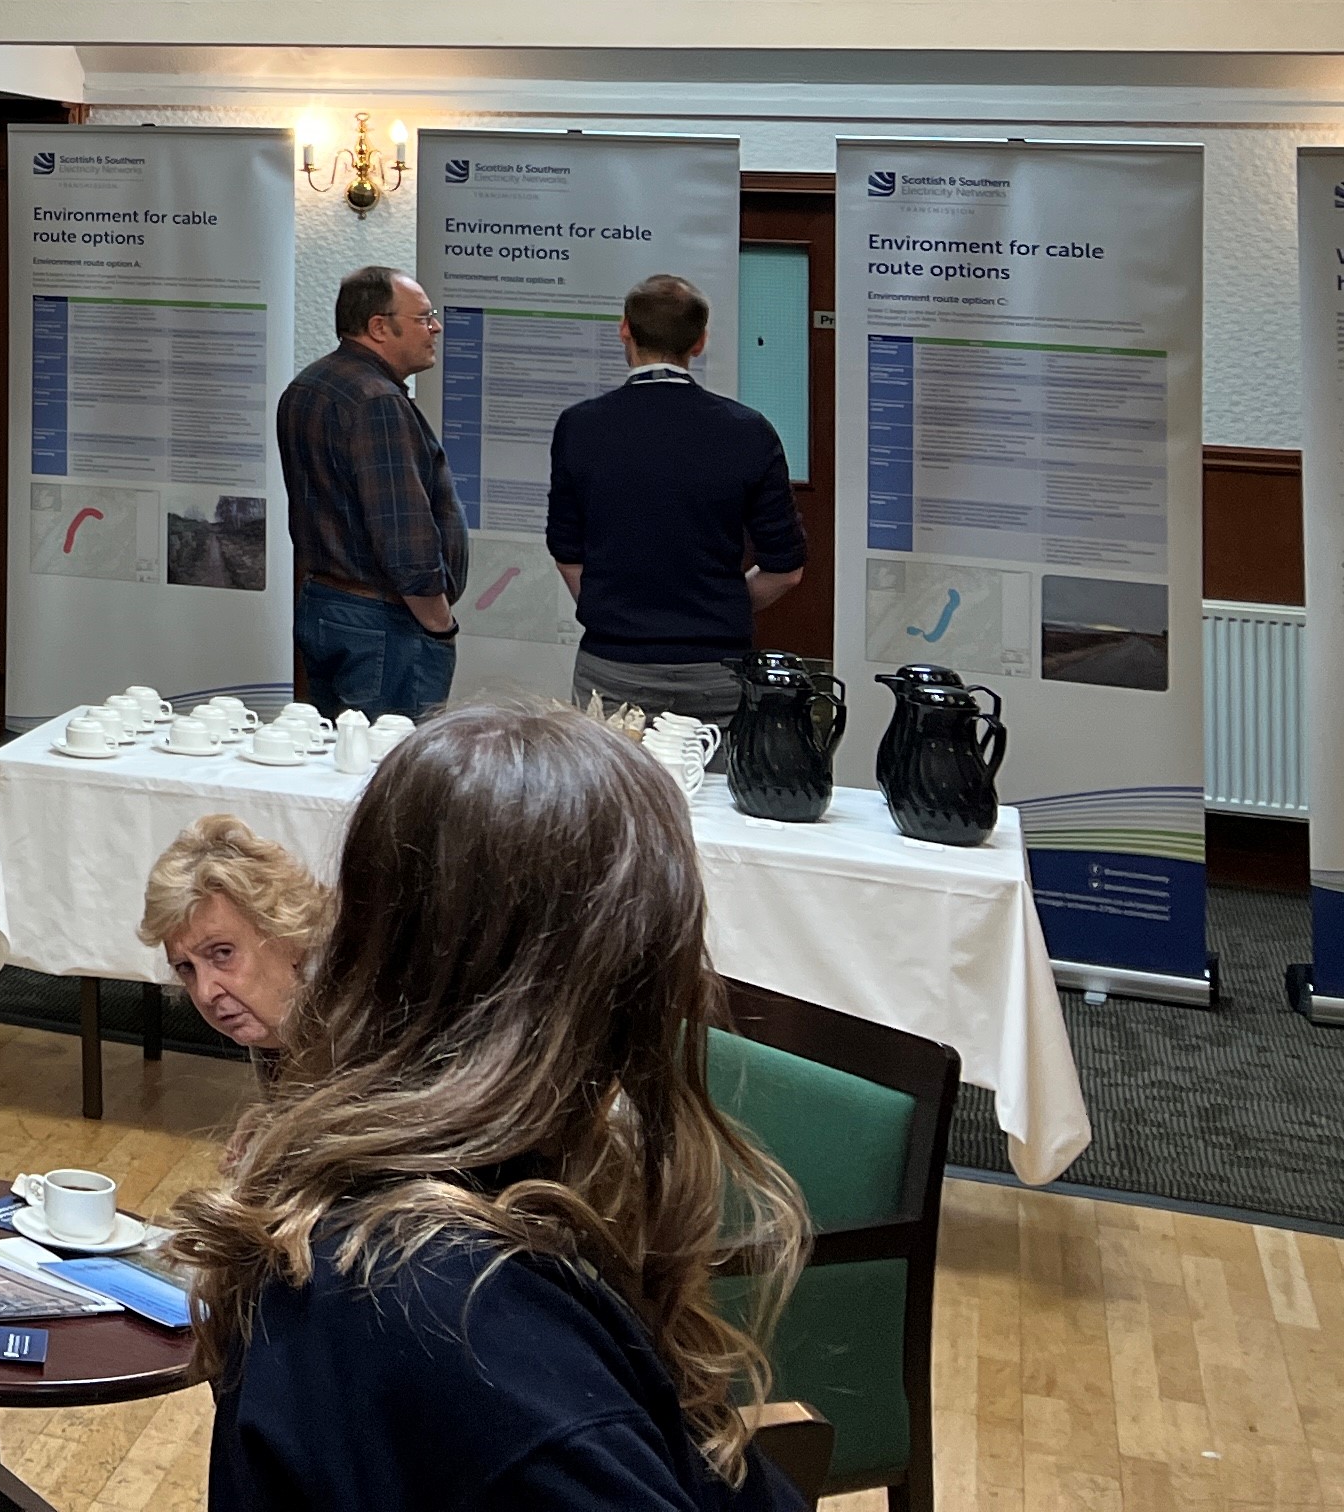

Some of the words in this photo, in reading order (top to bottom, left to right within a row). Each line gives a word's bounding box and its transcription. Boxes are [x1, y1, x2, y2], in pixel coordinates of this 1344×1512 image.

[60, 155, 95, 164] Scottish
[96, 156, 102, 164] &
[105, 156, 145, 165] Southern
[102, 166, 142, 174] Networks
[475, 163, 514, 173] Scottish
[516, 164, 523, 173] &
[525, 164, 570, 175] Southern
[902, 175, 946, 186] Scottish
[949, 177, 956, 186] &
[959, 177, 1010, 188] Southern
[902, 187, 952, 198] Electricity
[956, 187, 1007, 198] Networks
[33, 207, 138, 224] Environment
[144, 209, 167, 224] for
[172, 210, 218, 225] cable
[445, 218, 563, 237] Environment
[569, 223, 595, 239] for
[601, 225, 652, 241] cable
[33, 230, 76, 243] route
[82, 230, 144, 247] options
[444, 244, 493, 258] route
[499, 245, 570, 261] options
[869, 234, 1003, 254] Environment
[1009, 240, 1040, 256] for
[1046, 242, 1104, 259] cable
[33, 258, 81, 266] Environment
[84, 260, 104, 268] route
[106, 260, 132, 269] option
[868, 261, 924, 277] route
[930, 264, 1010, 280] options
[526, 276, 555, 285] option
[868, 291, 930, 303] Environment
[932, 295, 959, 304] route
[962, 295, 994, 306] option
[821, 315, 835, 325] Pr
